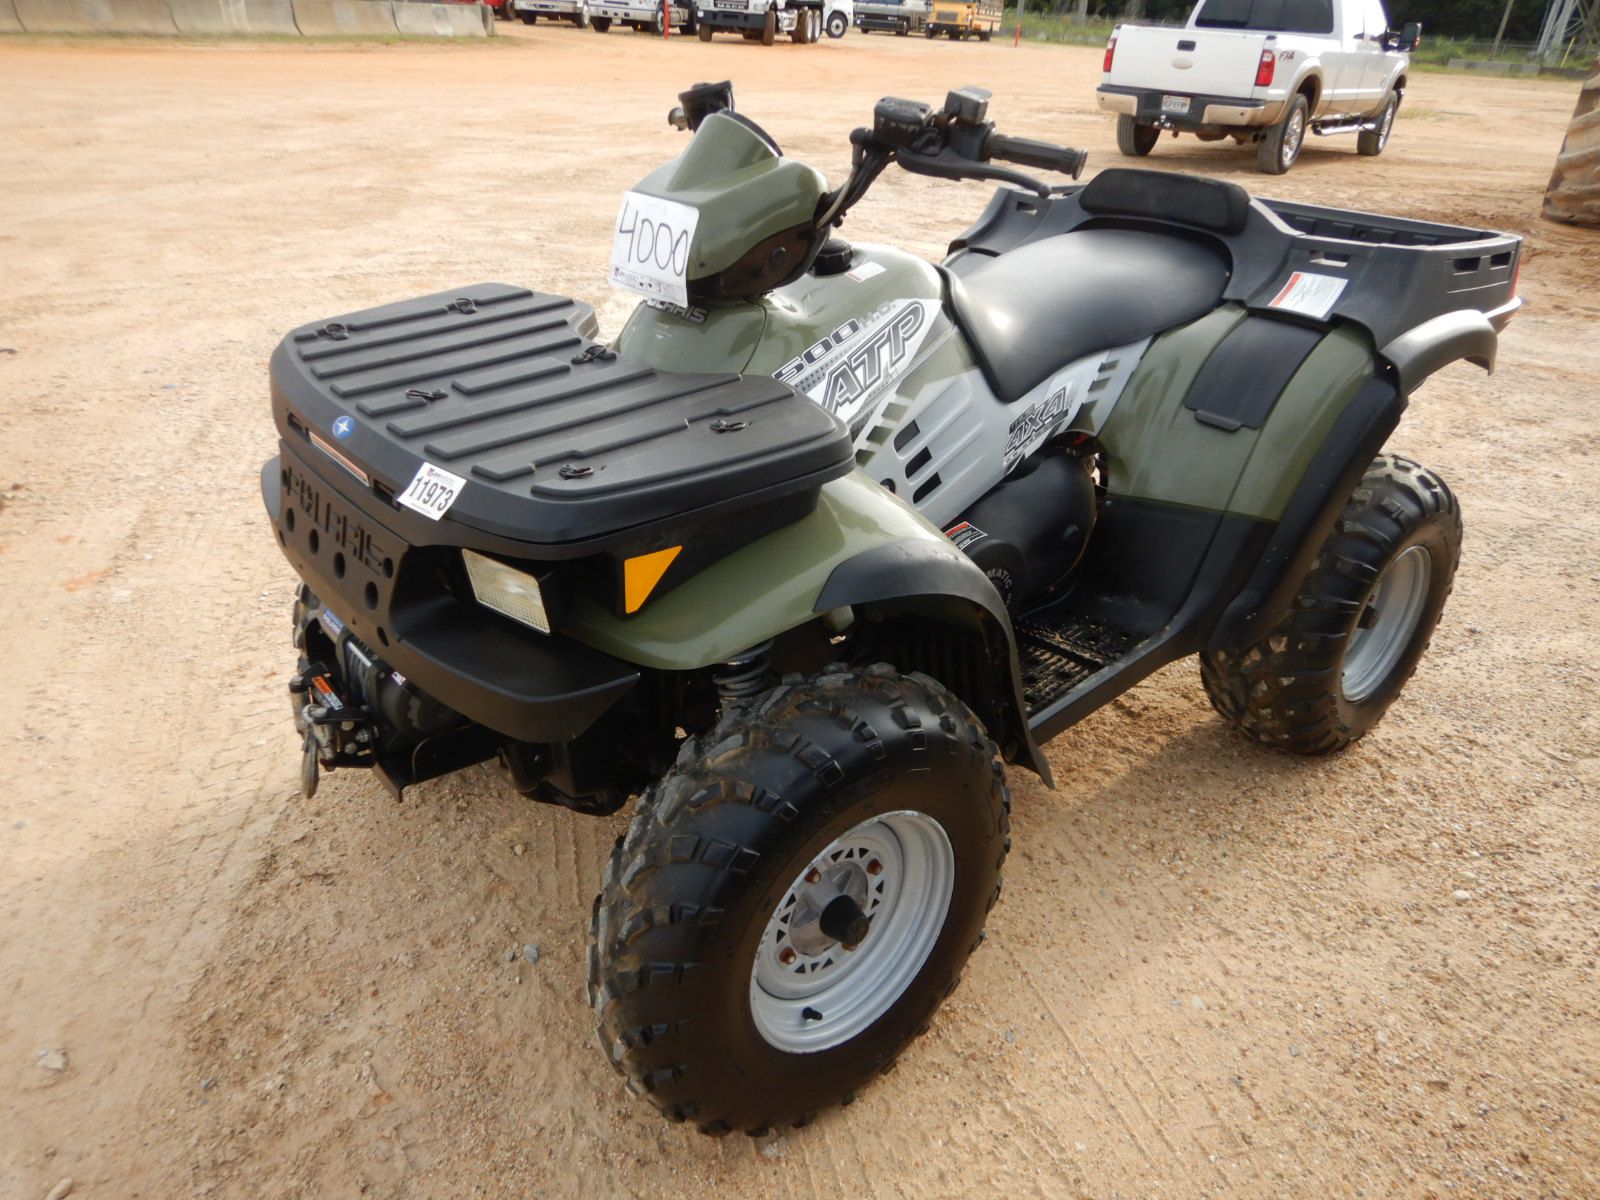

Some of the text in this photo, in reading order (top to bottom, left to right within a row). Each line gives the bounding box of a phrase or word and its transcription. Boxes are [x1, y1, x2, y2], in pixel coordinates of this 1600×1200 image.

[1279, 50, 1295, 60] FX4
[619, 199, 688, 276] 4000
[772, 318, 861, 384] 500
[822, 301, 925, 415] ATP
[409, 476, 454, 512] 11973
